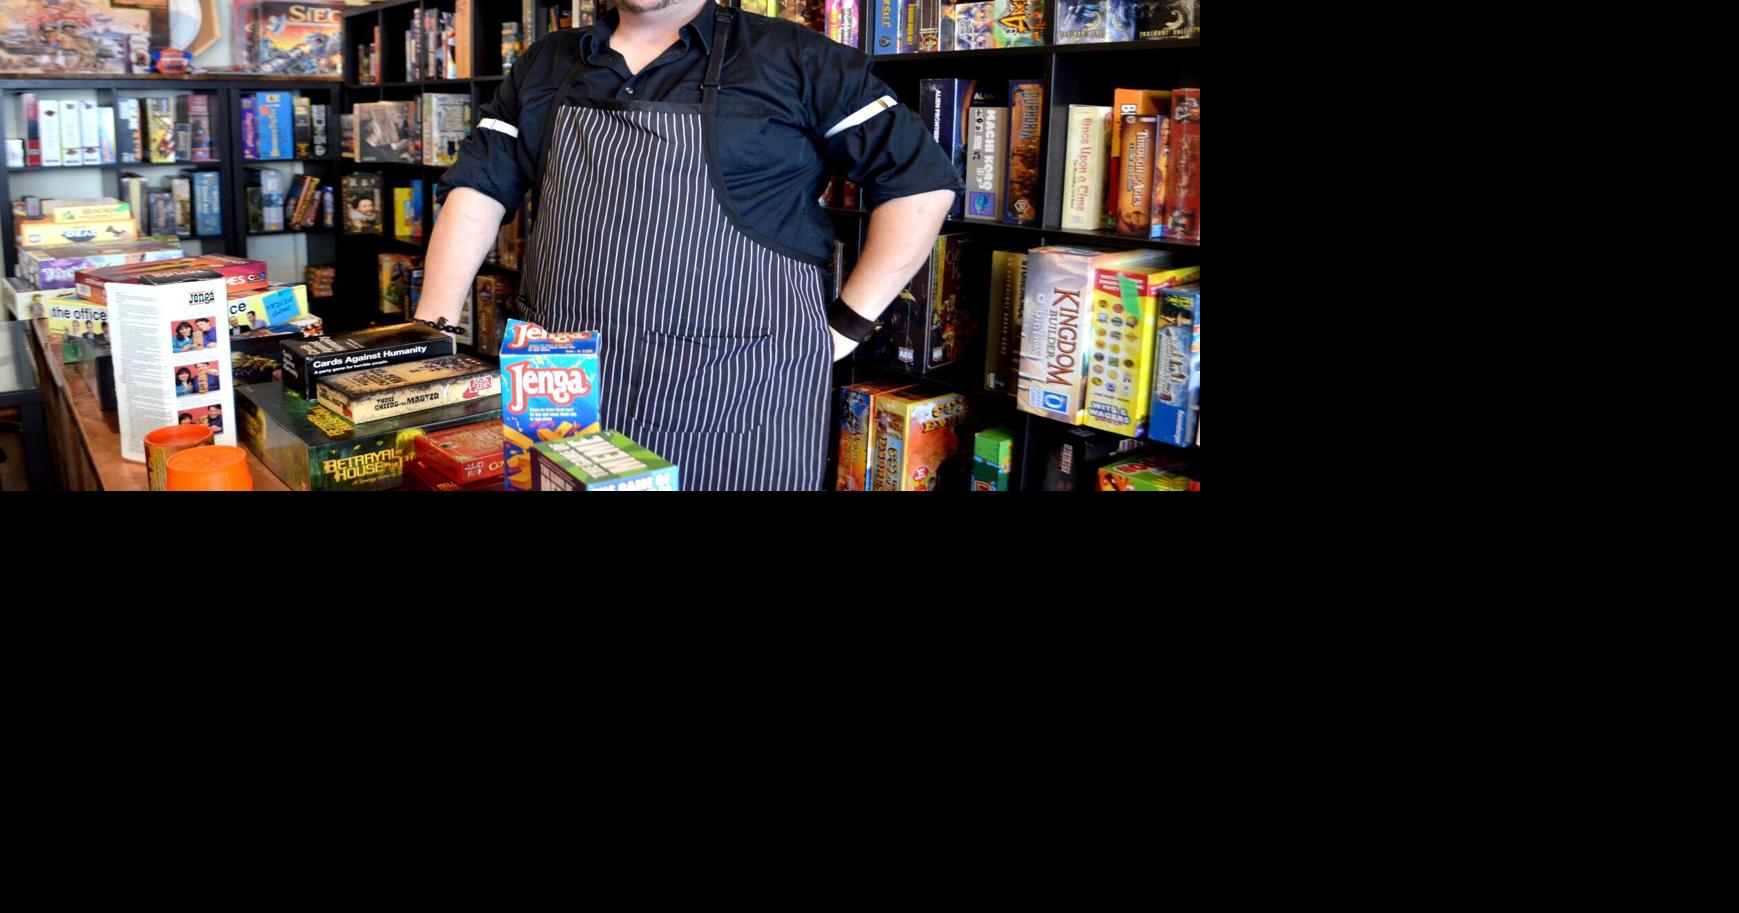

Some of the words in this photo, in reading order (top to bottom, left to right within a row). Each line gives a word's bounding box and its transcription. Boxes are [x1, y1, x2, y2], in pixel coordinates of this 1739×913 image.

[985, 109, 996, 153] MACHI
[1018, 92, 1040, 139] EUPHORIA
[983, 156, 995, 190] KORO
[52, 306, 70, 318] the
[74, 307, 107, 321] office
[188, 291, 214, 304] Jenga
[1046, 287, 1080, 386] KINGDOM
[1047, 310, 1058, 358] BUILDER
[313, 357, 342, 368] Cards
[345, 351, 381, 364] Against
[383, 345, 427, 358] Humanity
[507, 362, 590, 413] Jenga
[323, 448, 398, 474] BETRAYAL
[334, 462, 383, 482] HOUSE
